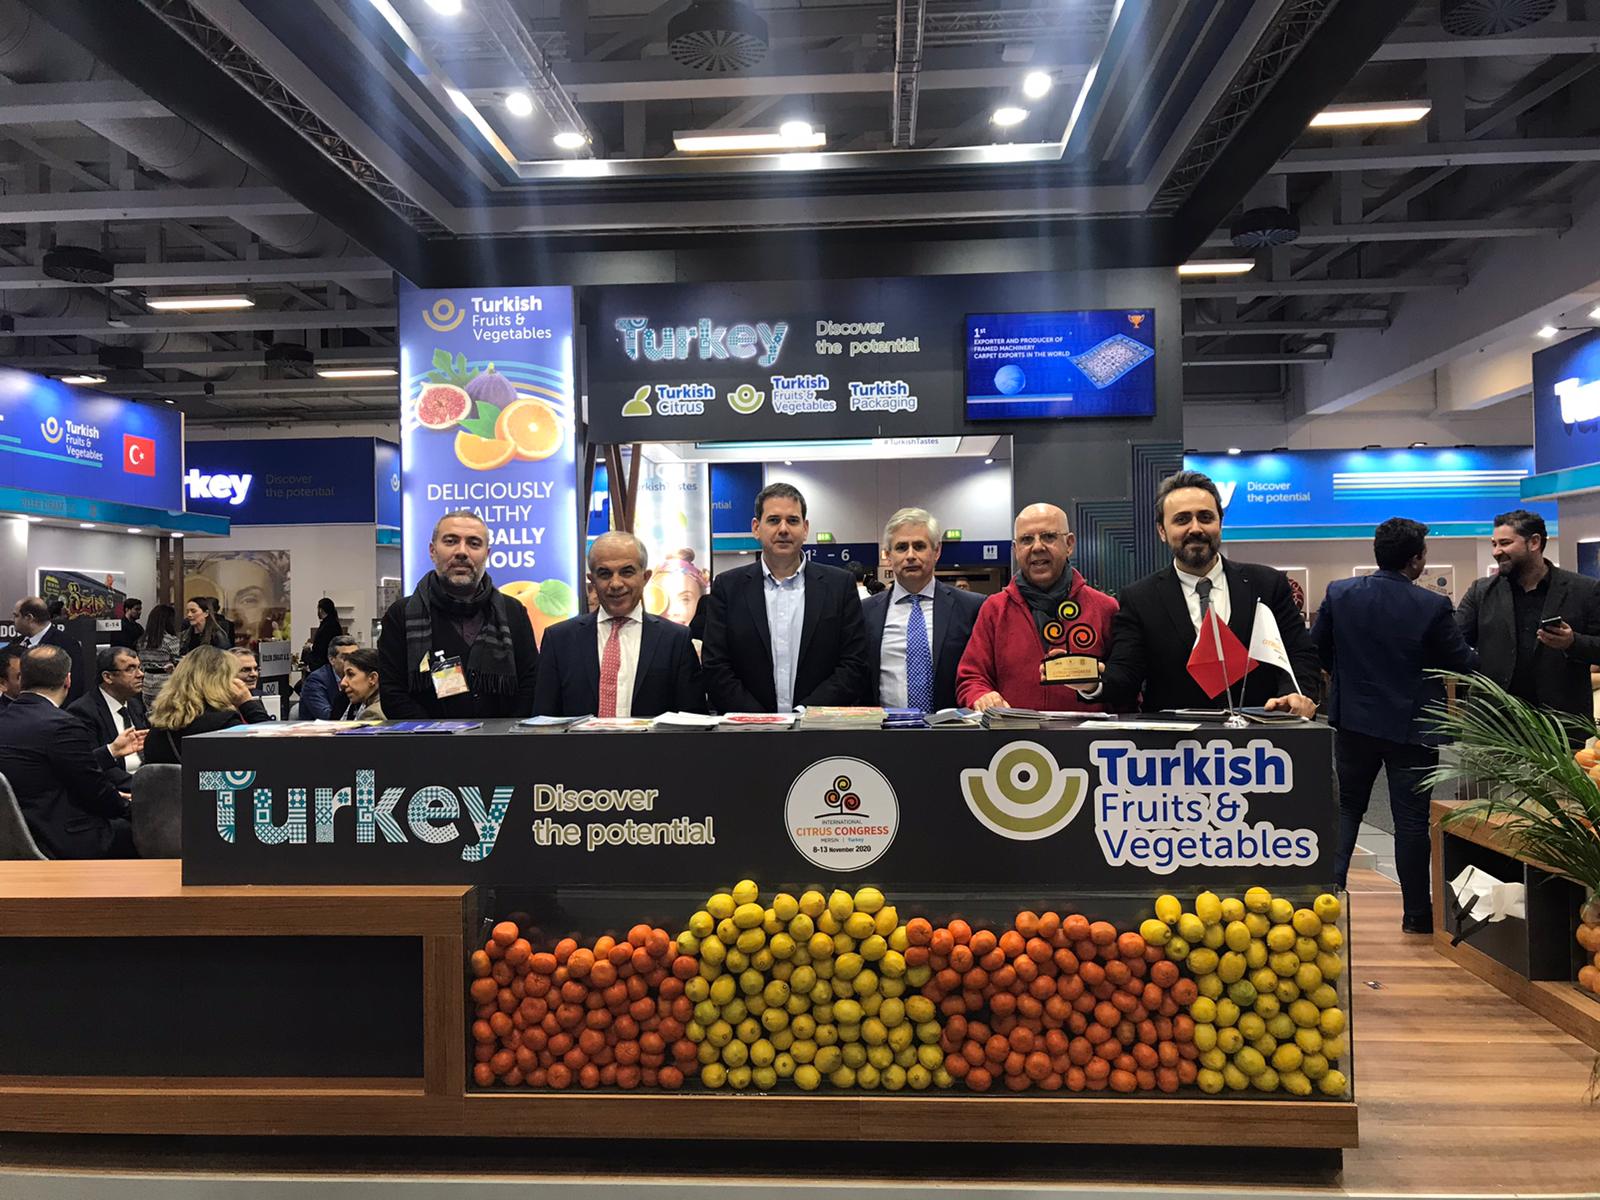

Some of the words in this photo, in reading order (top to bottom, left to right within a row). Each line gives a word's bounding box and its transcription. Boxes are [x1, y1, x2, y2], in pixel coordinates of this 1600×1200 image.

[471, 295, 542, 313] Turkish
[472, 314, 511, 327] Fruits
[515, 313, 525, 326] &
[473, 326, 552, 343] Vegetables
[816, 320, 885, 336] Discover
[974, 327, 986, 338] 1st
[615, 317, 789, 367] Turkey
[815, 339, 843, 354] the
[850, 337, 920, 357] potential
[1021, 336, 1053, 344] PRODUCER
[998, 351, 1025, 359] EXPORTS
[772, 376, 828, 390] Turkish
[851, 382, 908, 397] Turkish
[657, 385, 714, 400] Turkish
[773, 390, 803, 400] Fruits
[806, 391, 814, 399] &
[658, 401, 704, 414] Citrus
[774, 400, 835, 413] Vegetables
[852, 397, 917, 411] Packaging
[65, 419, 100, 440] Turkish
[66, 434, 85, 447] Fruits
[86, 438, 91, 448] &
[65, 445, 103, 461] Vegetables
[184, 469, 252, 505] key
[265, 474, 312, 485] Discover
[1247, 481, 1291, 491] Discover
[265, 488, 284, 497] the
[286, 487, 335, 499] potential
[427, 481, 554, 501] DELICIOUSLY
[1247, 493, 1264, 502] the
[1265, 491, 1311, 505] potential
[712, 501, 732, 509] ntial
[445, 505, 532, 522] ALTHY
[488, 527, 545, 545] BALLY
[841, 549, 850, 561] 6
[1096, 746, 1286, 787] Turkish
[533, 784, 659, 812] Discover
[1101, 792, 1203, 823] Fruits
[1215, 791, 1242, 823] &
[199, 769, 515, 862] Turkey
[532, 817, 581, 845] the
[586, 816, 716, 852] potential
[796, 827, 832, 837] CITRUS
[834, 826, 889, 836] CONGRESS
[812, 845, 828, 853] 8-13
[855, 845, 872, 853] 2020
[1102, 828, 1312, 867] Vegetables
